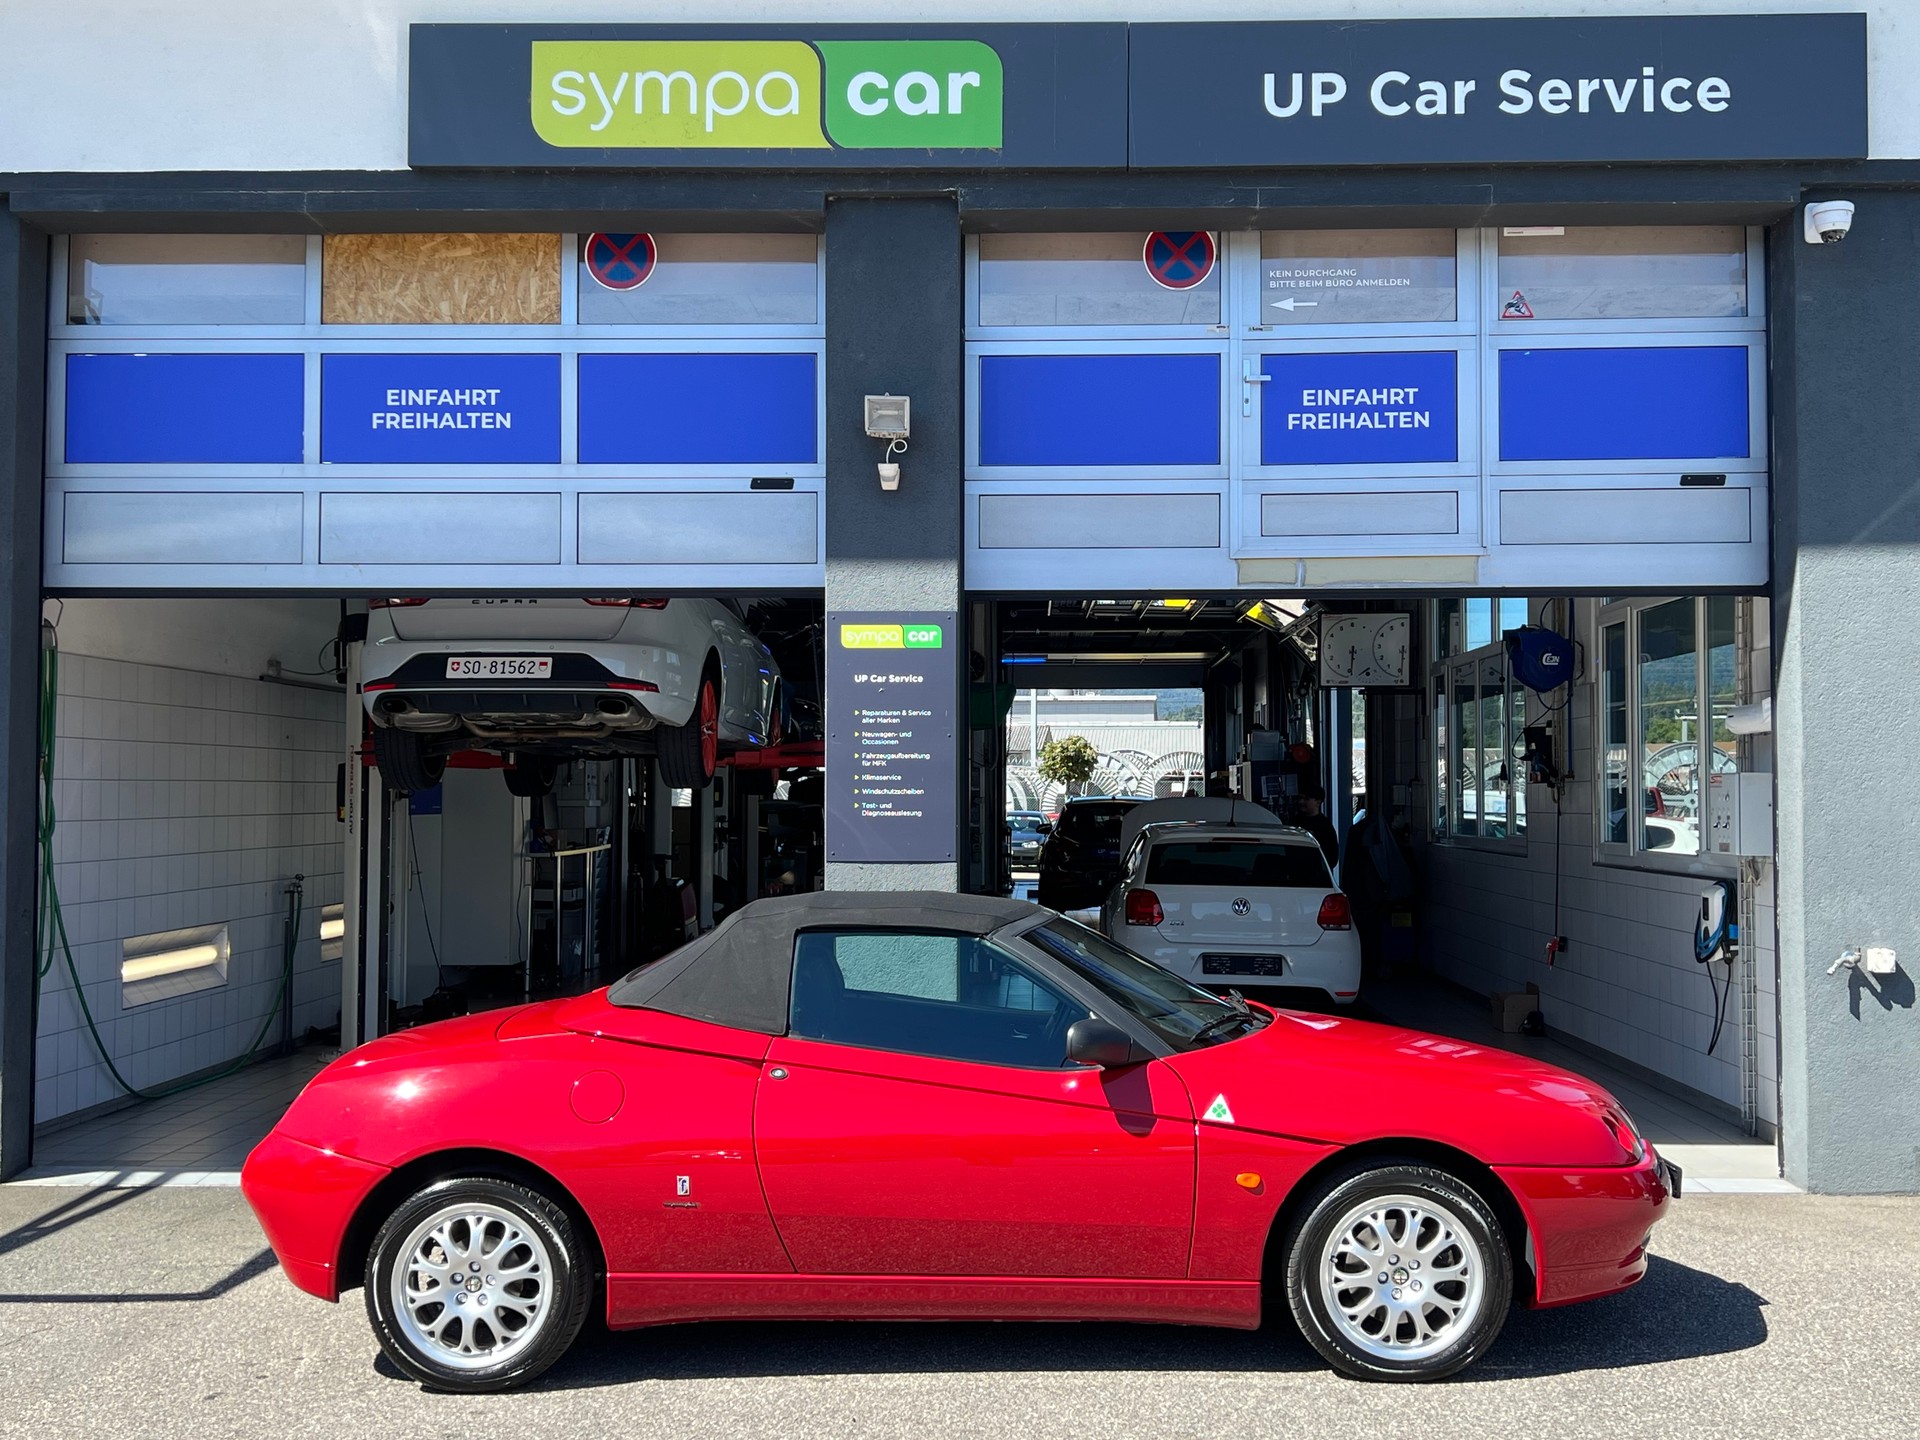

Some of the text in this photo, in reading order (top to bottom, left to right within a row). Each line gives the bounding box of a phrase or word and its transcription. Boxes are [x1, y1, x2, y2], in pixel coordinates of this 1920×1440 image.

[1264, 66, 1731, 118] UP Car Service
[551, 70, 980, 133] sympa car
[1269, 268, 1357, 278] KEIN DURCHGANG
[1269, 278, 1410, 288] BITTE BEIM BÜRO ANMELDEN
[387, 389, 501, 407] EINFAHRT
[1303, 388, 1419, 406] EINFAHRT
[372, 412, 512, 430] FREIHALTEN
[1288, 411, 1430, 430] FREIHALTEN
[845, 630, 938, 645] sympa car
[854, 674, 924, 683] UP Car Service
[861, 709, 901, 717] Reparaturen
[861, 731, 899, 739] Neuwagen-
[861, 752, 931, 760] Fahrzeugaufbereitung
[861, 810, 922, 818] Diagnoseauslesung
